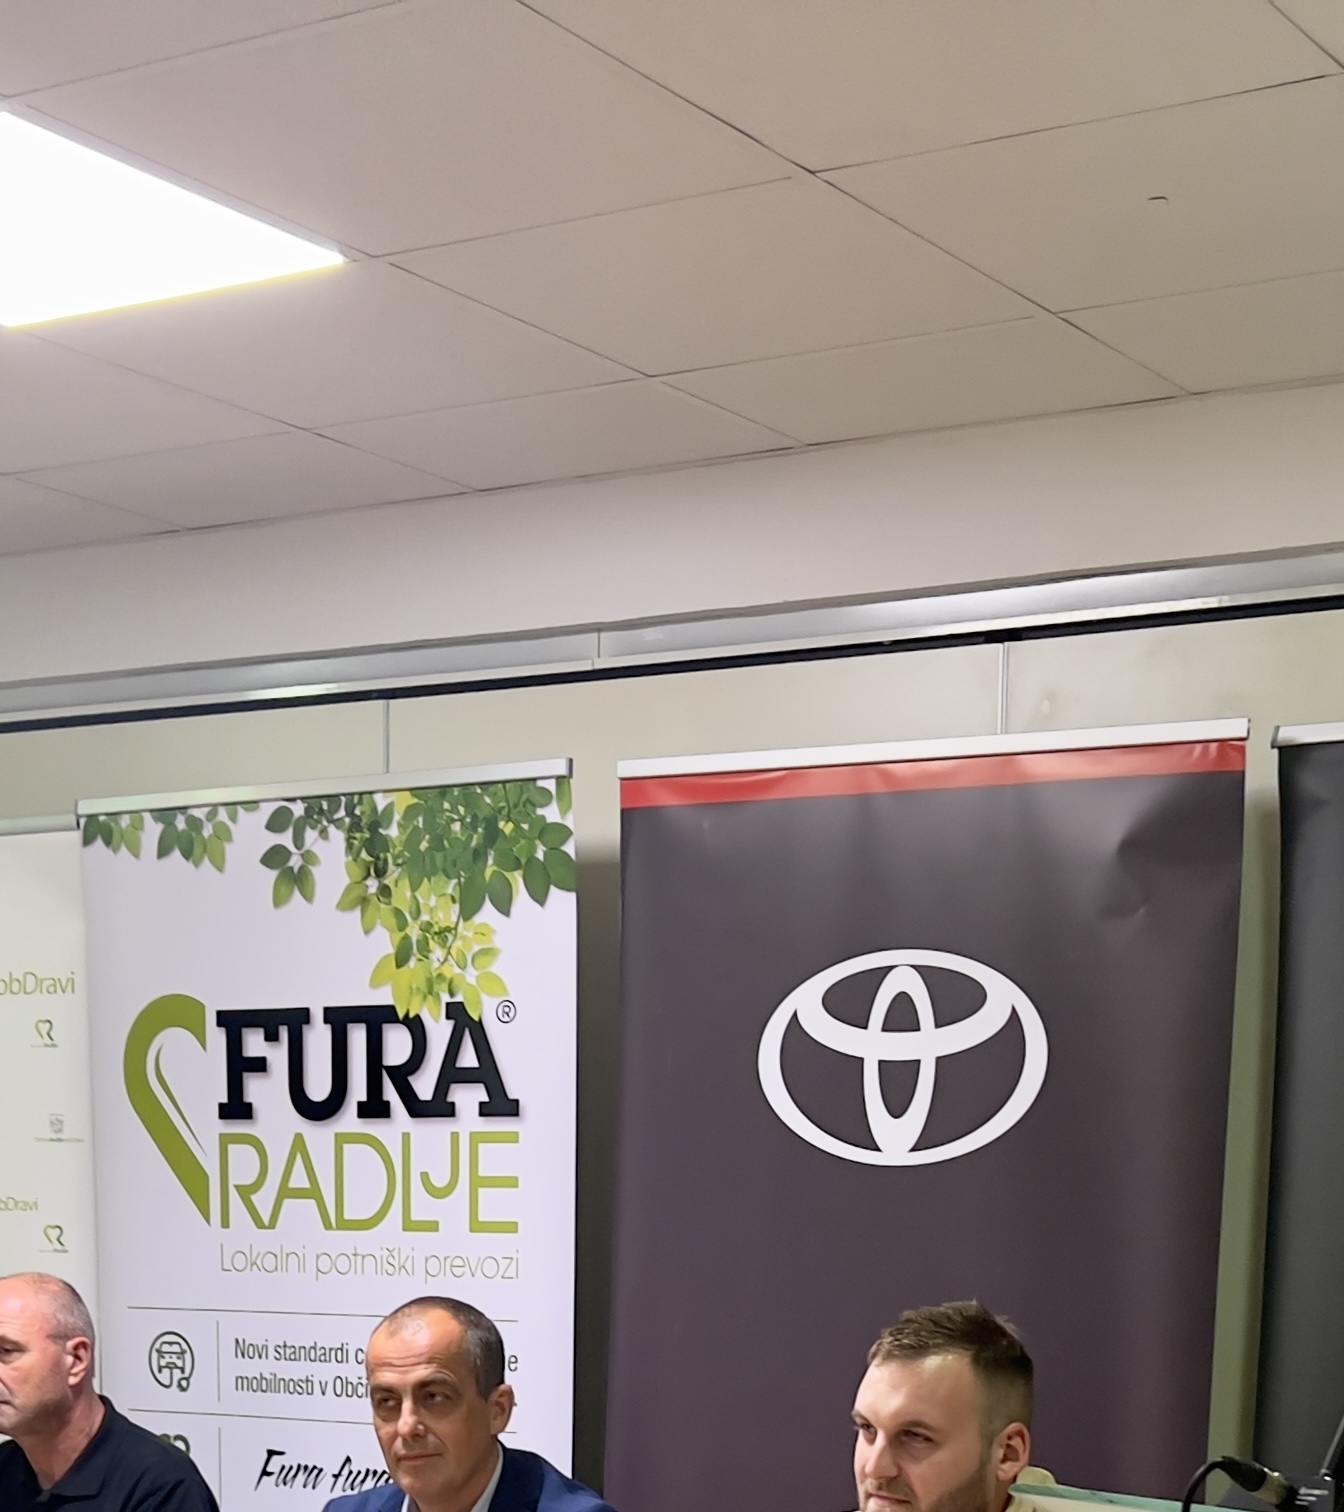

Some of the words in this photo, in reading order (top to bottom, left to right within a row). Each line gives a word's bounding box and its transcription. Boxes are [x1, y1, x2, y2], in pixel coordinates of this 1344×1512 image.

[216, 1001, 520, 1120] FURA
[220, 1243, 306, 1274] Lokalni
[316, 1246, 415, 1281] potniški
[425, 1250, 519, 1284] prevozi
[234, 1338, 269, 1360] Novi
[273, 1340, 349, 1364] standardi
[234, 1372, 314, 1396] mobilnosti
[318, 1380, 328, 1396] v
[333, 1375, 369, 1399] Obči
[255, 1449, 326, 1492] Fura
